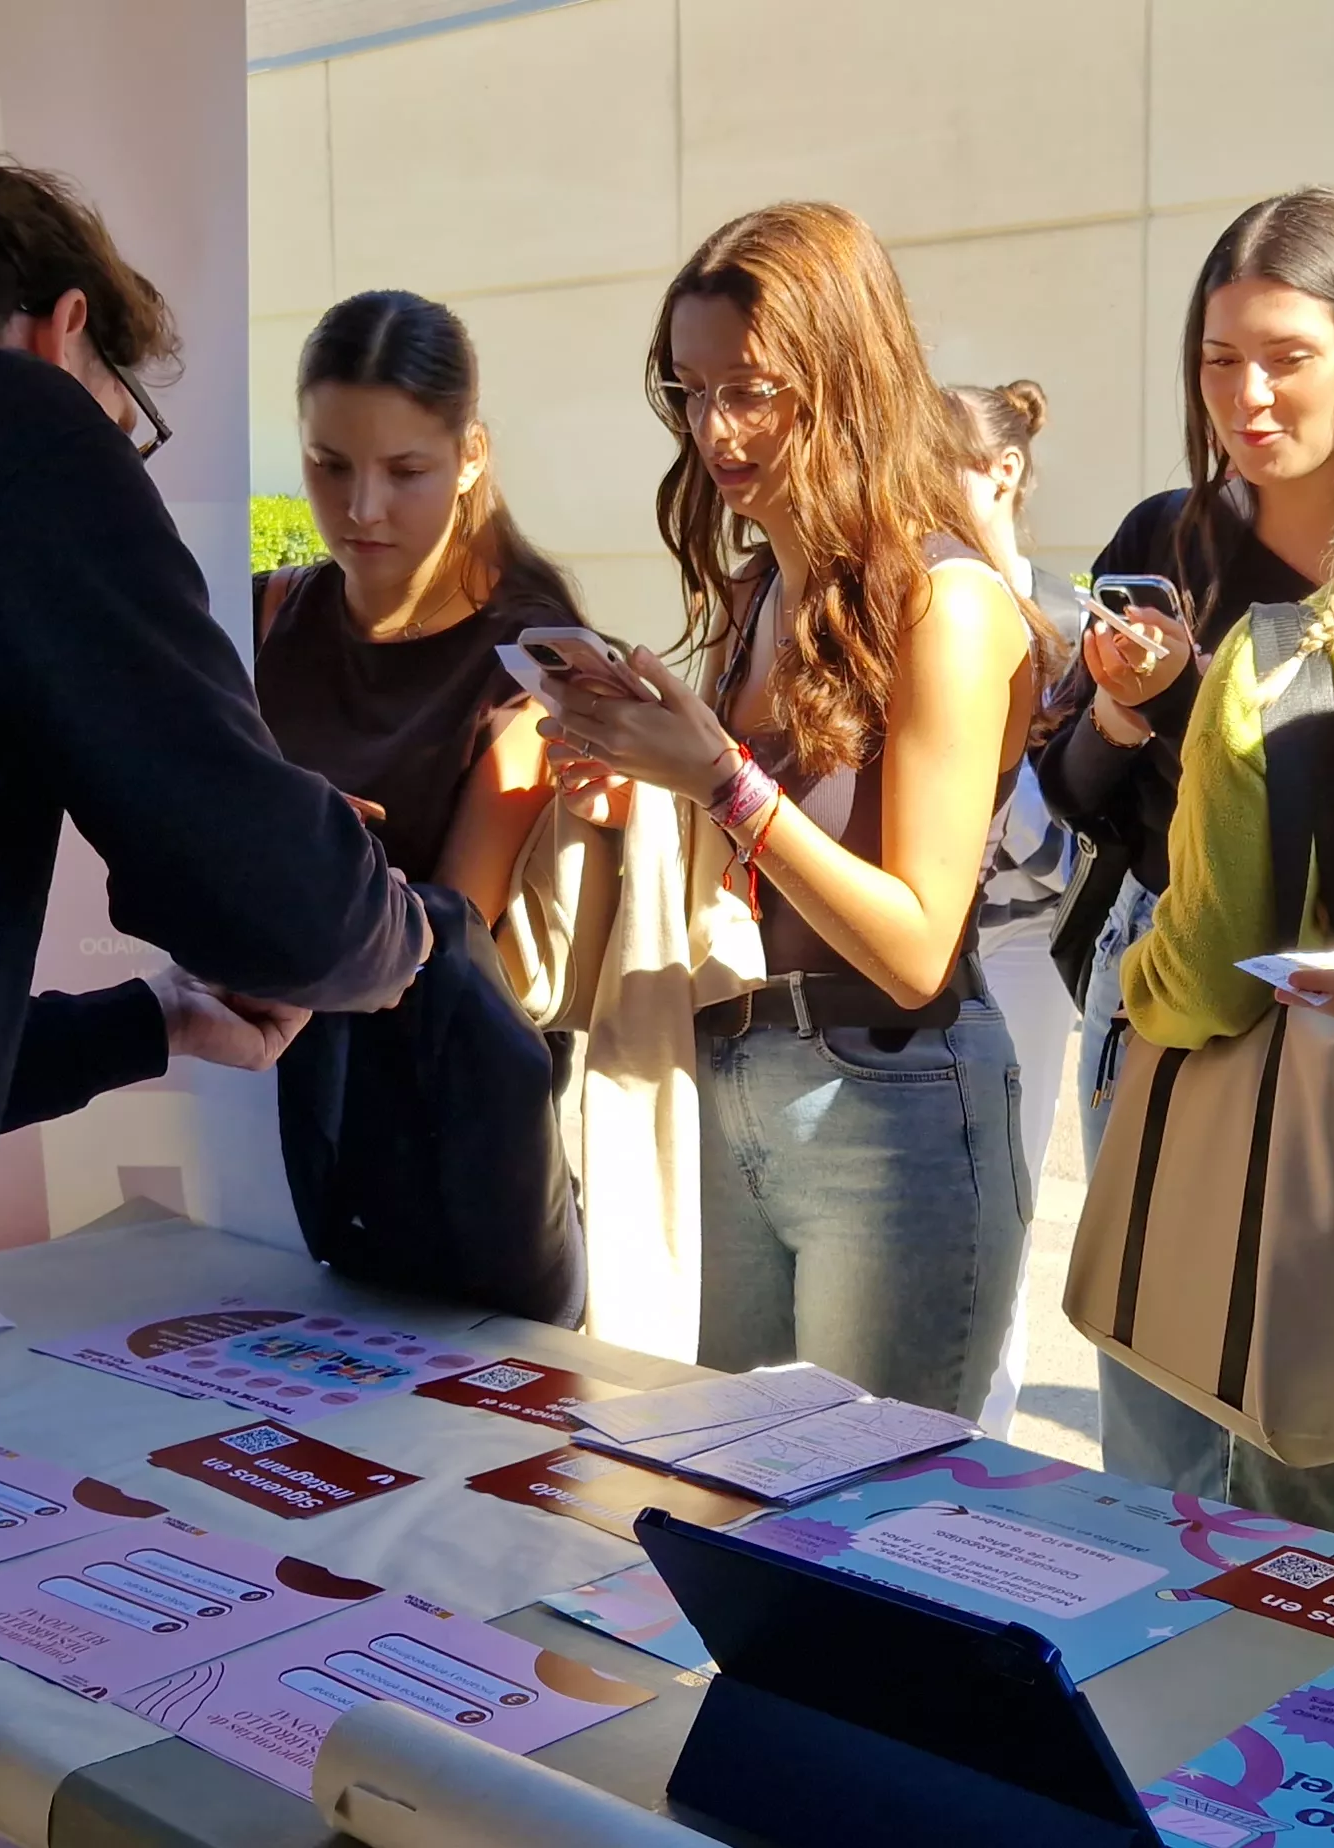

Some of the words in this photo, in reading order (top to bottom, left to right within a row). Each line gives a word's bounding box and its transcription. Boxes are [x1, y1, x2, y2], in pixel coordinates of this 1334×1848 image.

[202, 1457, 233, 1475] en
[253, 1456, 356, 1499] Instagram
[229, 1468, 324, 1509] Síguenos
[1260, 1595, 1303, 1613] en
[198, 1713, 229, 1728] de
[229, 1710, 323, 1751] SARROLLO
